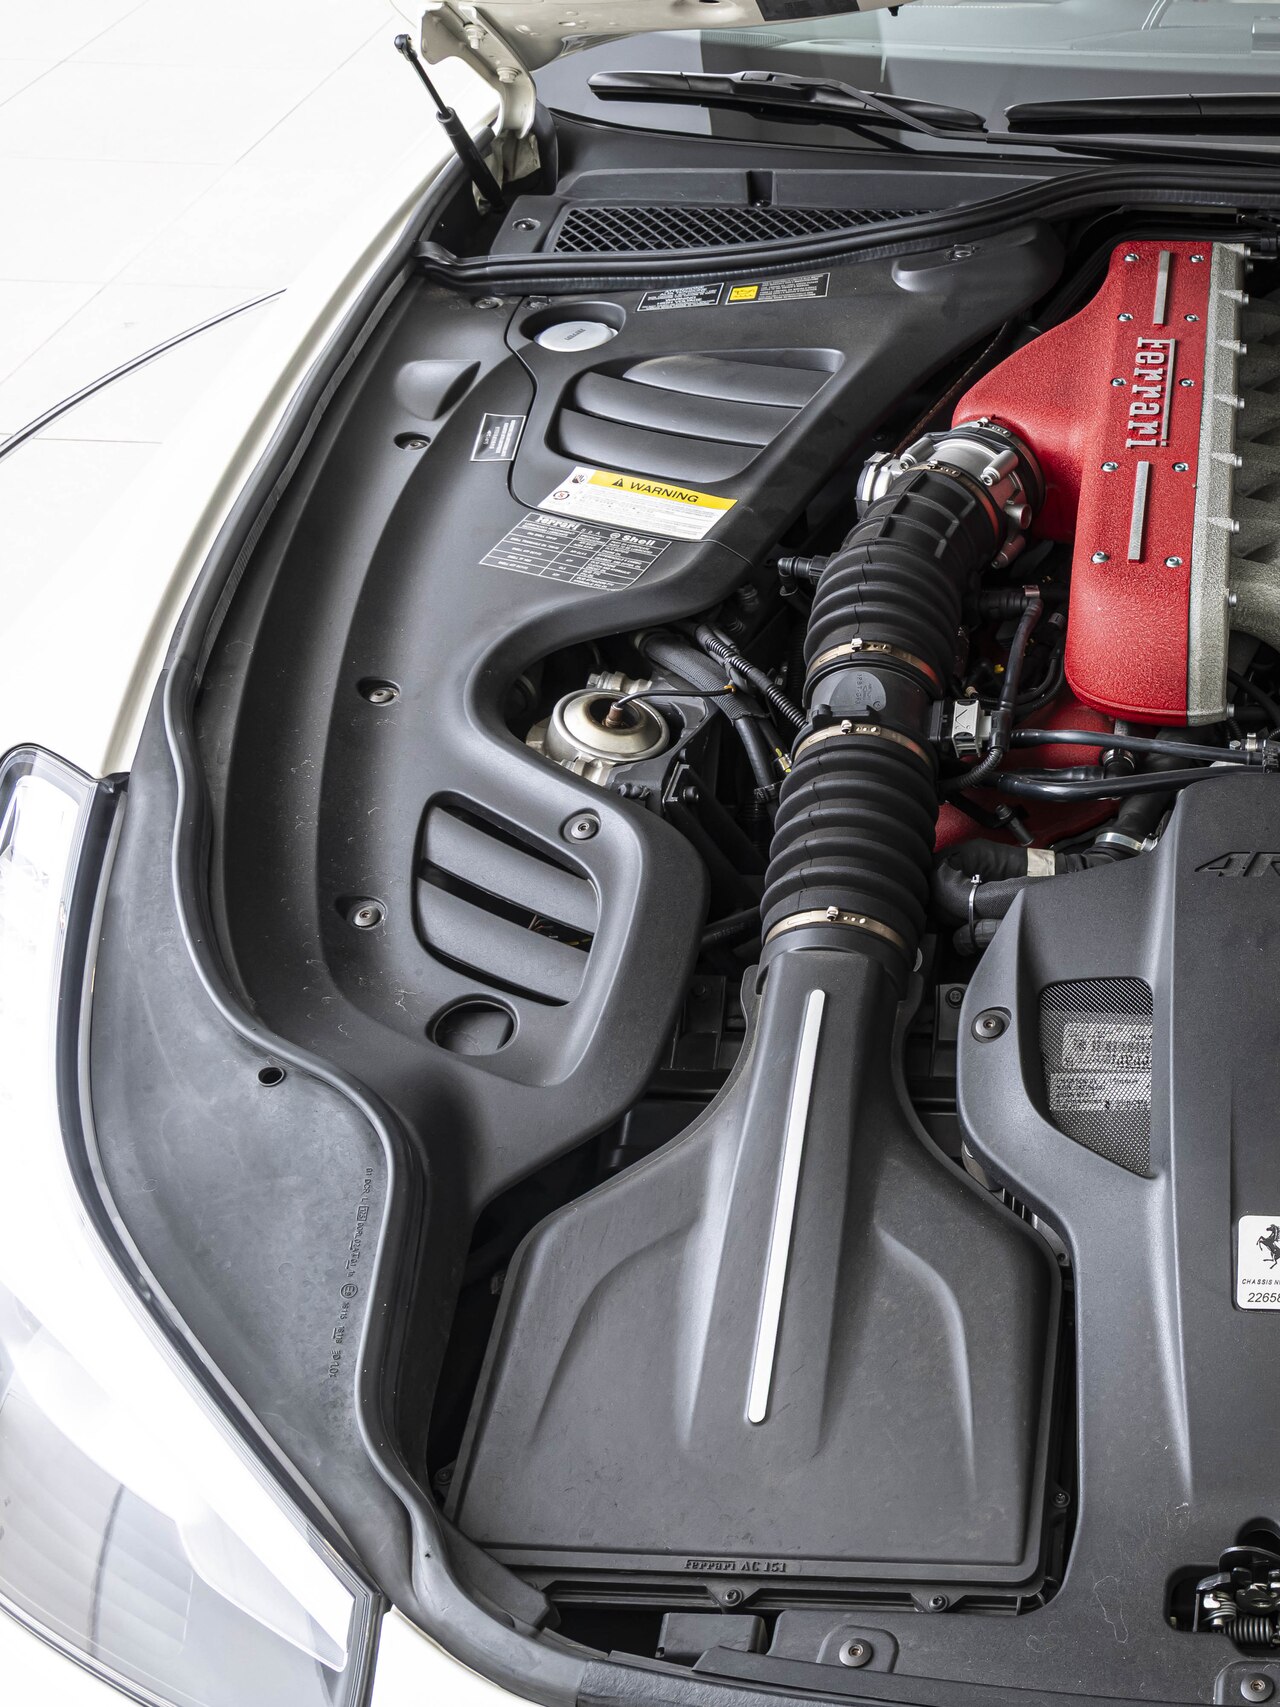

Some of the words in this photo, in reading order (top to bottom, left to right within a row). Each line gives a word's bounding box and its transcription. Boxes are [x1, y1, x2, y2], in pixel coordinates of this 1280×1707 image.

[1125, 336, 1177, 448] Ferrari
[630, 481, 699, 504] WARNING
[622, 534, 656, 546] Shell
[1241, 1278, 1273, 1286] CHASSIS
[684, 1559, 737, 1571] Ferrari
[740, 1561, 761, 1572] AC
[763, 1561, 787, 1573] 151
